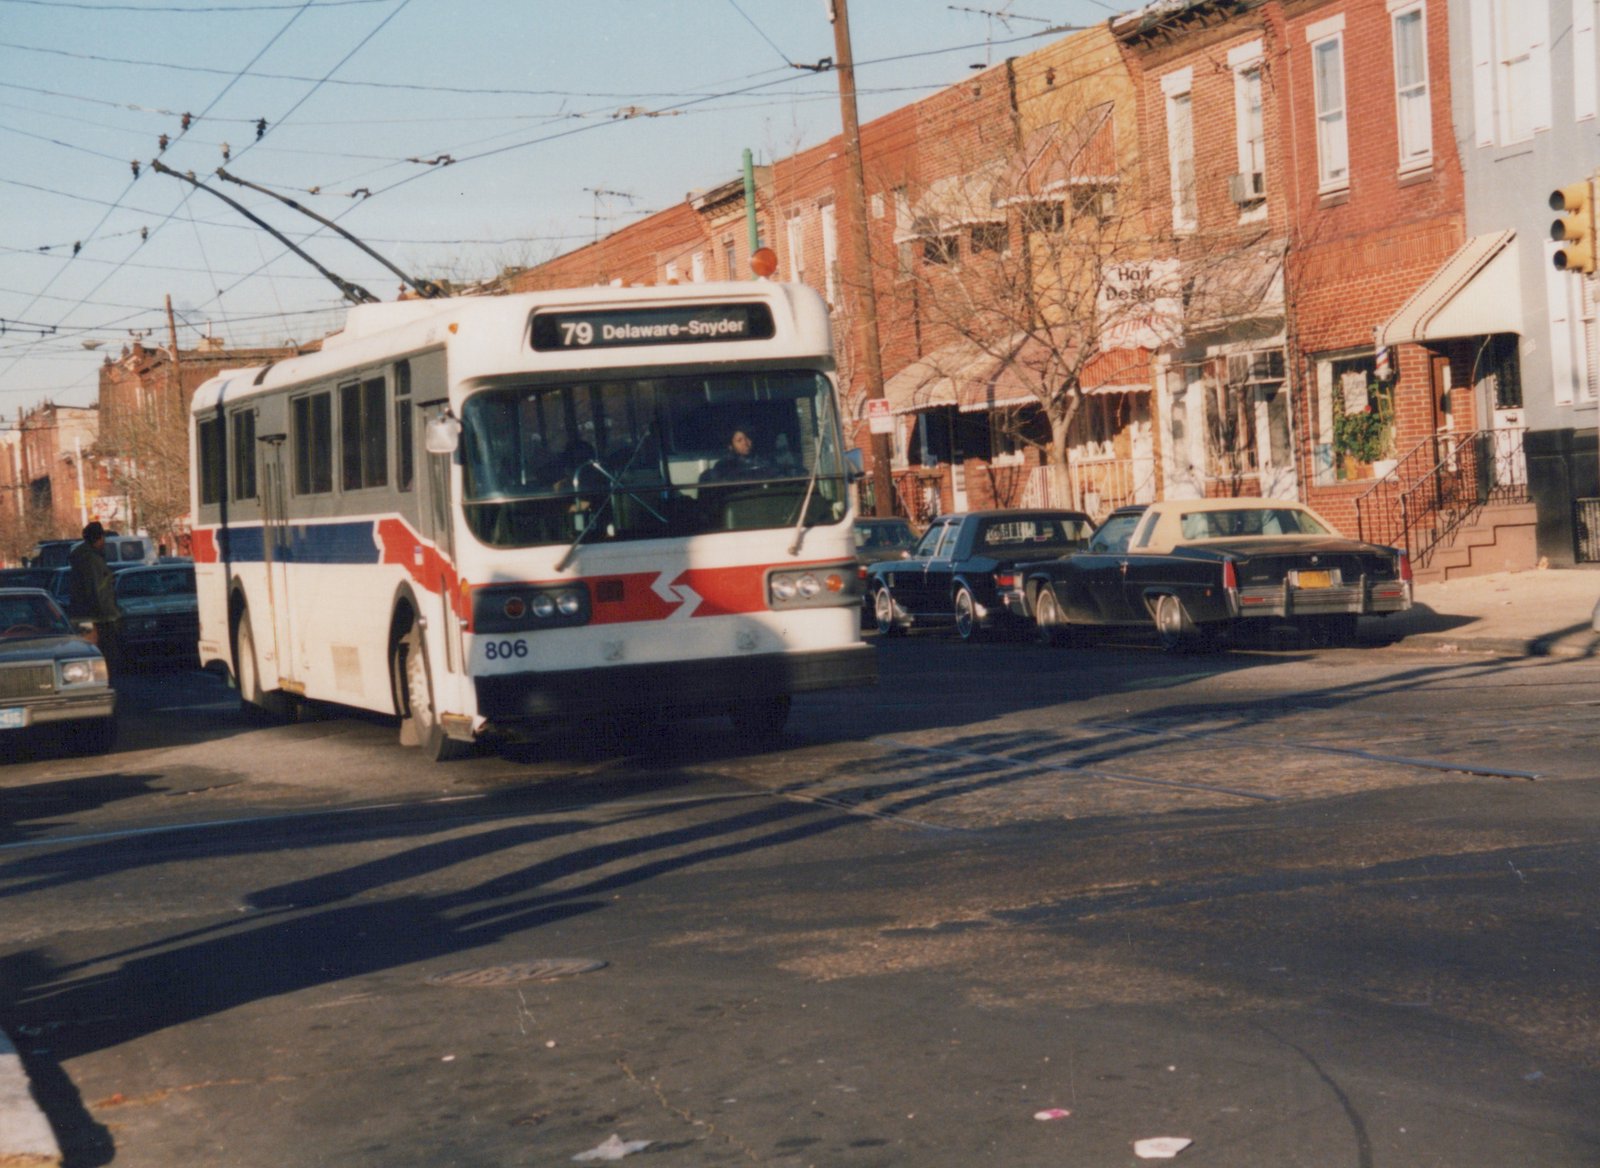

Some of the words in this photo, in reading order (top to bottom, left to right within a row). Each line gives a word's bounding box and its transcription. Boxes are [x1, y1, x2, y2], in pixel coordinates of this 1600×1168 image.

[1118, 265, 1152, 281] Hair
[560, 322, 594, 346] 79
[602, 318, 745, 340] Delaware-Snyder
[485, 639, 529, 661] 806
